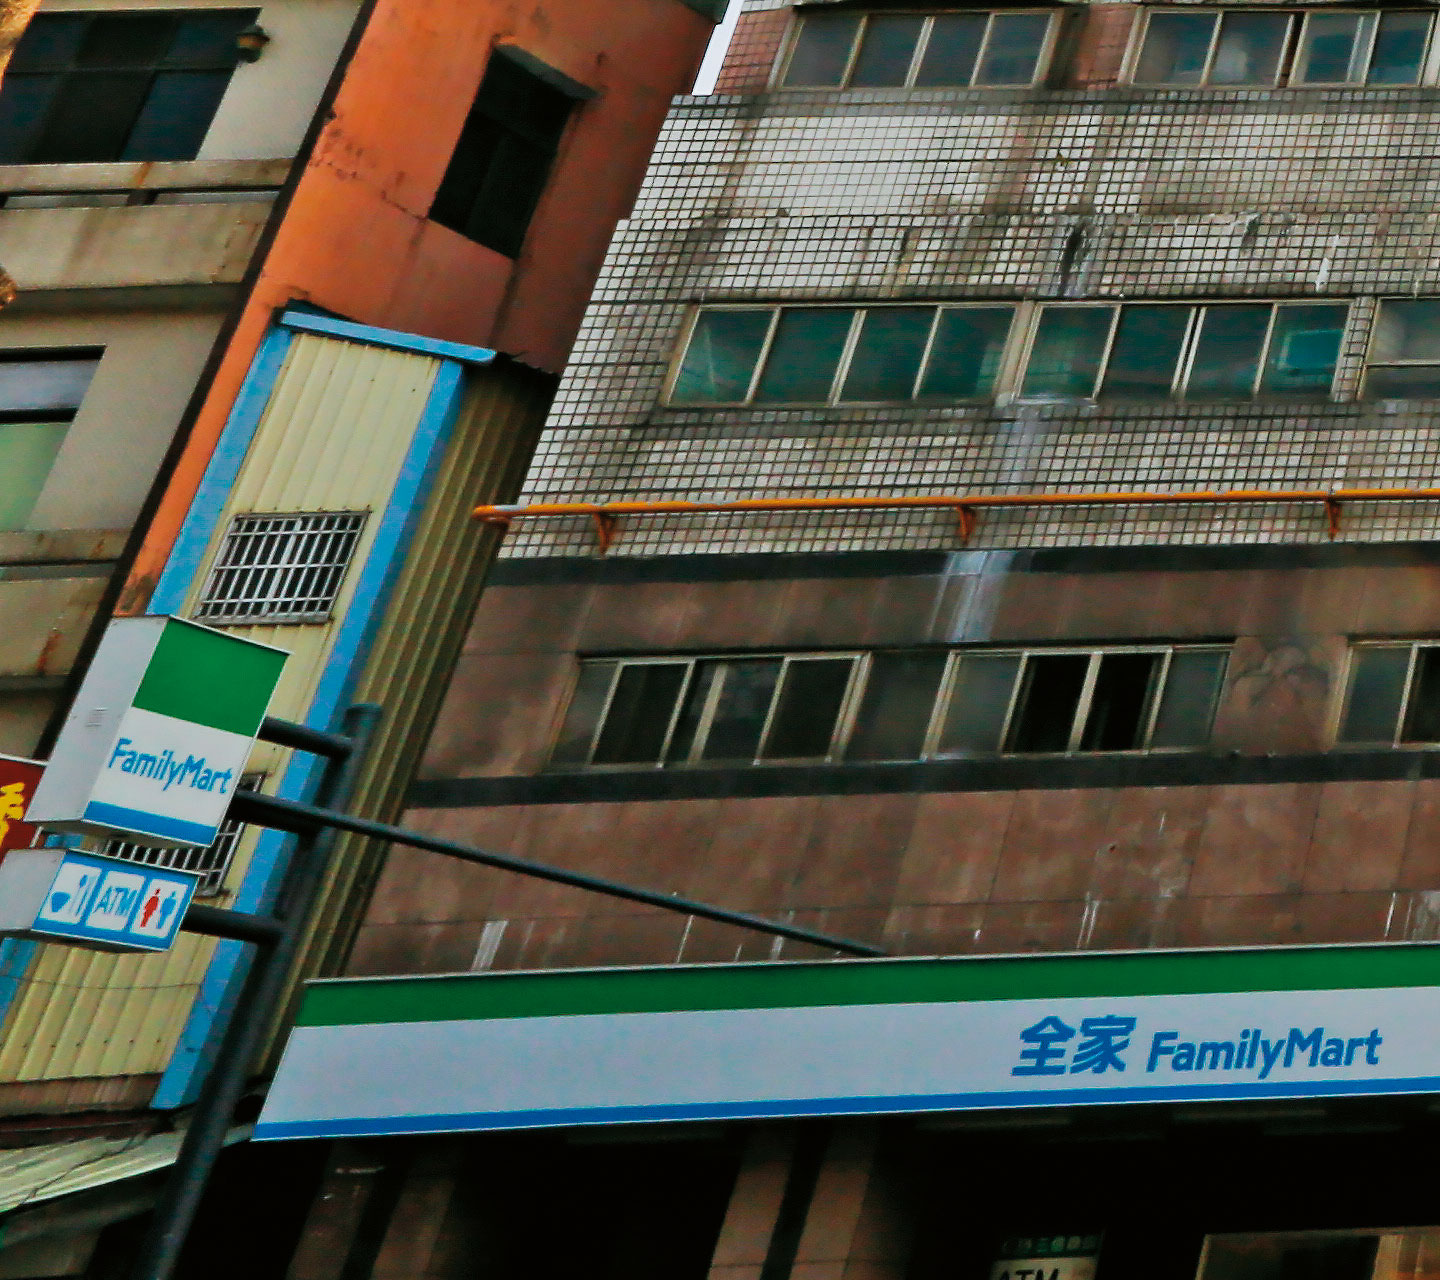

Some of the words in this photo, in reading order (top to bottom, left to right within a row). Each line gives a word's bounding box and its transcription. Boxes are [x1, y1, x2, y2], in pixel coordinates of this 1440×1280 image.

[107, 736, 233, 794] FamilyMart
[92, 885, 138, 918] ATM
[1010, 1014, 1138, 1077] 全家
[1145, 1027, 1384, 1081] FamilyMart
